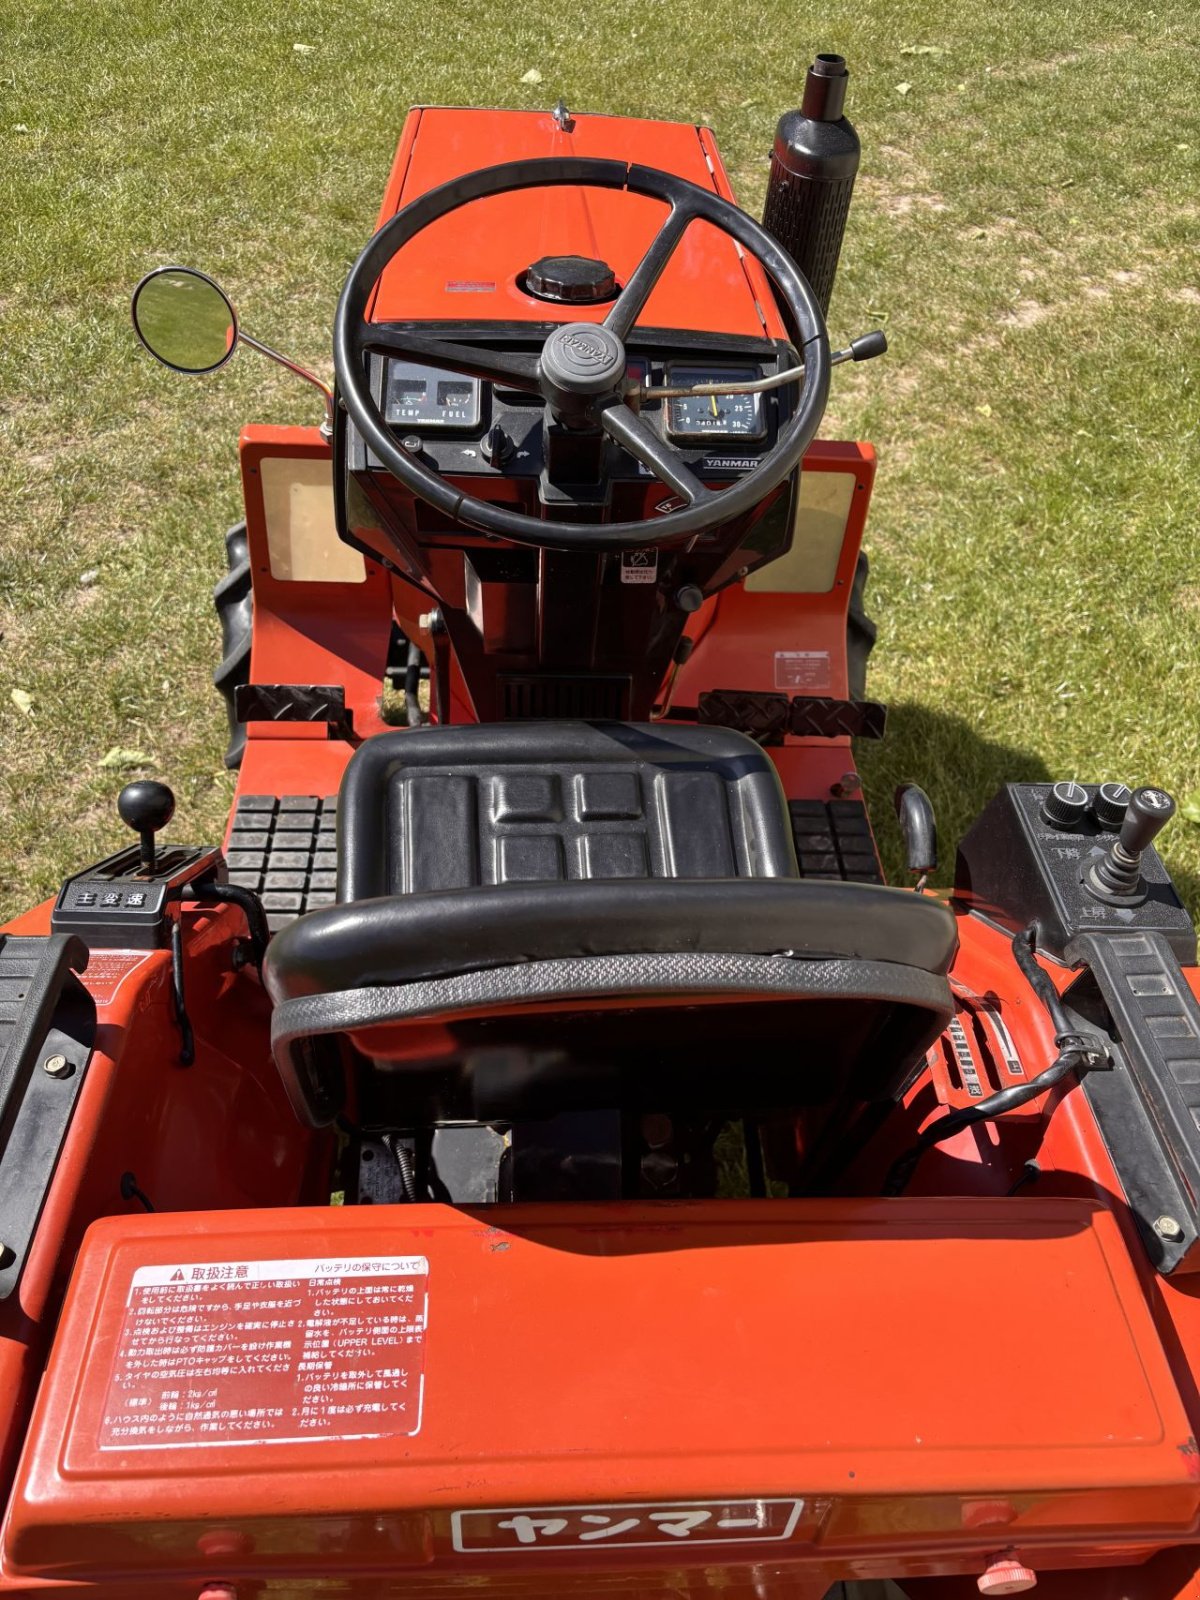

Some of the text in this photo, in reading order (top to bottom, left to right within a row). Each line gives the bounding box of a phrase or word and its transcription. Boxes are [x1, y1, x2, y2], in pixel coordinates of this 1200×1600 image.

[706, 459, 759, 467] YANMAR
[76, 892, 144, 906] 主変速
[191, 1265, 249, 1280] 取扱注意
[315, 1261, 419, 1273] バッテリの保守について
[498, 1510, 759, 1544] ヤンマー
